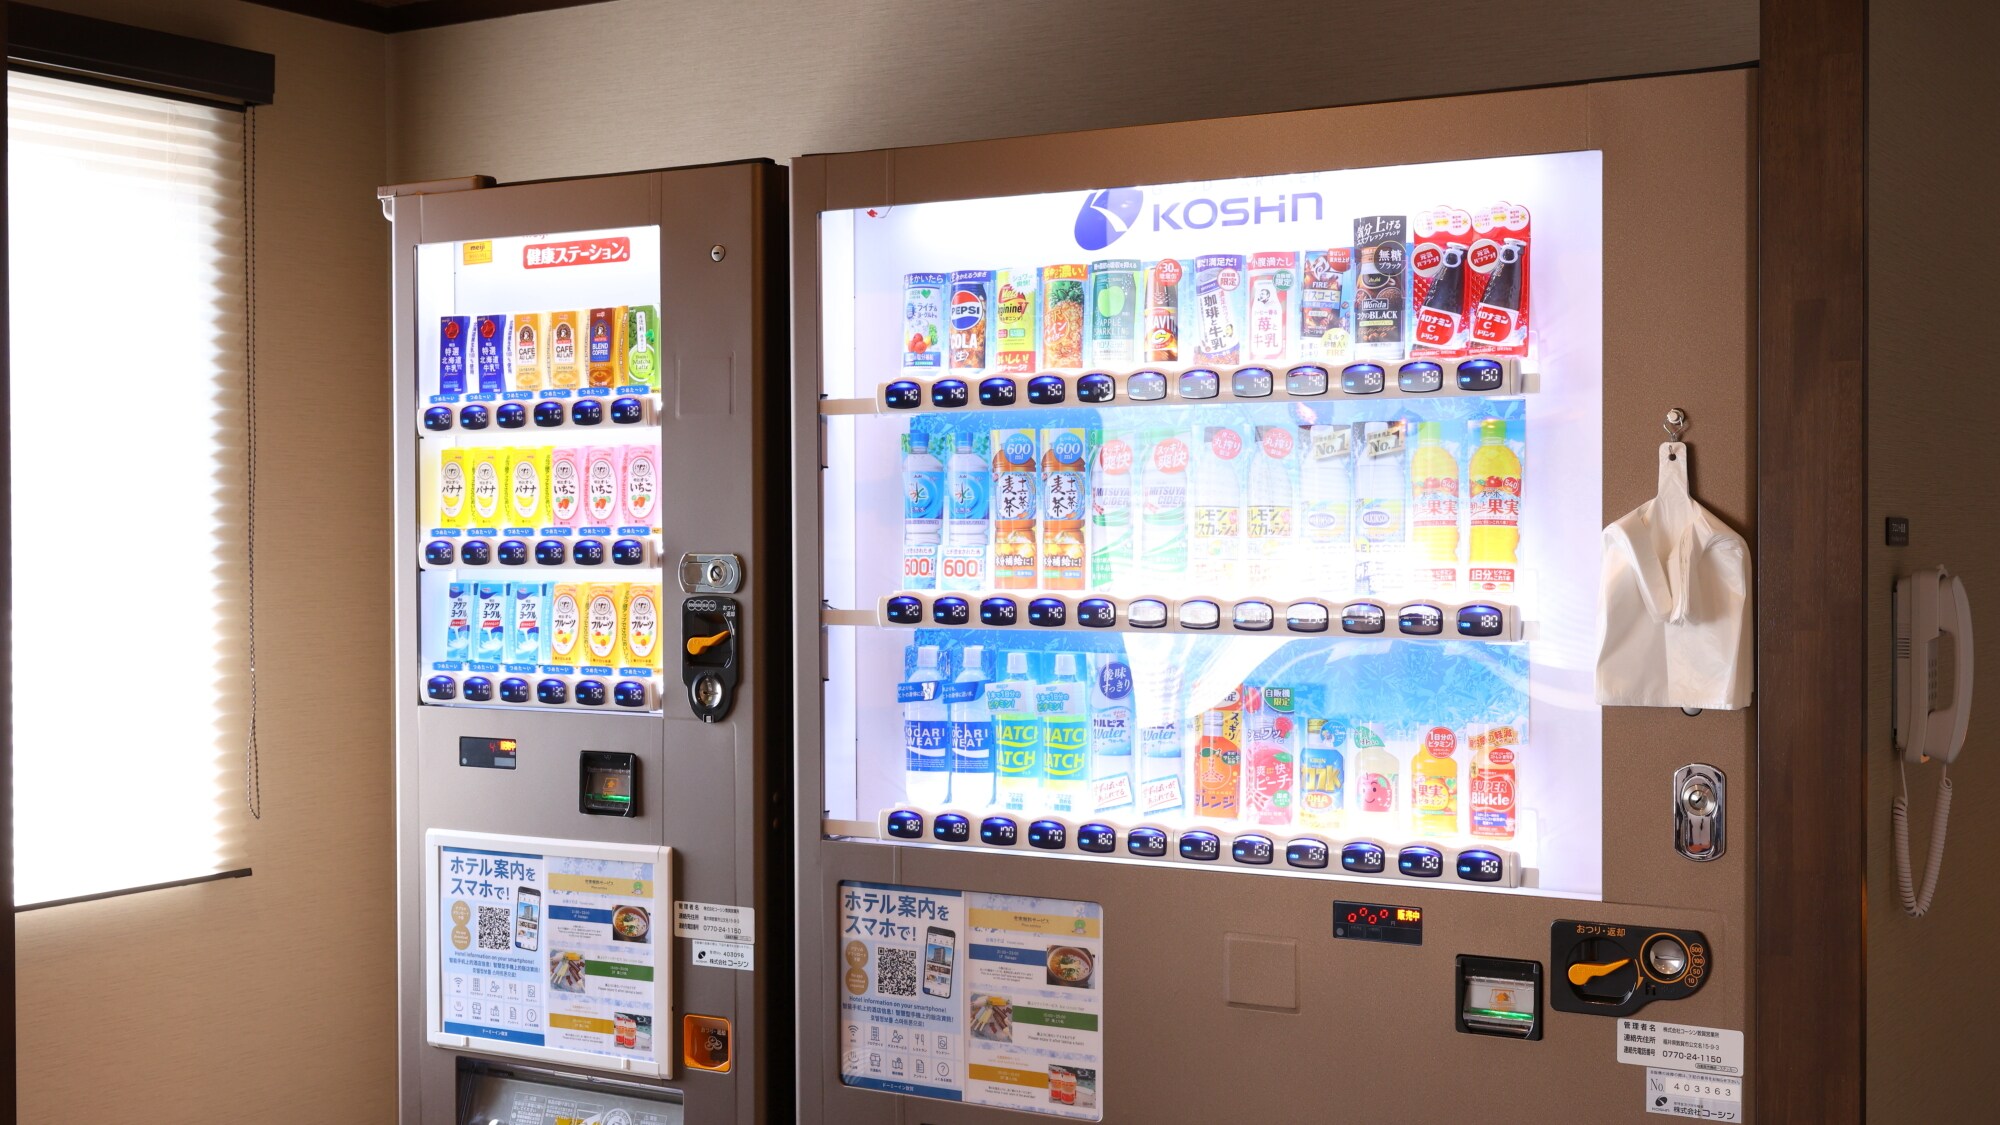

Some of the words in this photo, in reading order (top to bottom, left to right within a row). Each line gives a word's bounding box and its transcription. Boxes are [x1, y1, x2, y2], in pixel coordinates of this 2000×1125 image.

[1379, 250, 1402, 262] 無糖
[1380, 262, 1402, 270] ブラック
[952, 306, 980, 314] PEPSI
[1363, 300, 1387, 309] Wonda
[1370, 310, 1398, 320] BLACK
[1420, 314, 1452, 327] オロナミン
[1482, 322, 1492, 330] C
[1364, 373, 1381, 385] 160
[1422, 370, 1438, 384] 150
[1481, 368, 1498, 382] 150
[1254, 377, 1269, 388] 140
[904, 390, 918, 400] 140
[951, 388, 965, 399] 140
[998, 386, 1012, 397] 140
[1048, 384, 1062, 396] 150
[1006, 443, 1031, 455] 600
[1056, 443, 1080, 455] 600
[1213, 438, 1241, 450] 丸搾り
[1264, 437, 1292, 450] 丸搾り
[1368, 430, 1402, 458] No.1
[442, 484, 462, 494] バナナ
[476, 485, 496, 494] バナナ
[515, 485, 536, 494] バナナ
[554, 485, 576, 494] いちご
[591, 484, 612, 494] いちご
[630, 482, 652, 492] いちご
[1150, 486, 1186, 496] MITSUYA
[1504, 480, 1518, 490] 540
[1002, 475, 1020, 517] 麦茶
[1050, 475, 1068, 517] 麦茶
[1097, 487, 1130, 496] MITSUYA
[1103, 496, 1130, 506] CIDER
[1158, 496, 1185, 505] CIDER
[1428, 500, 1458, 516] 果実
[1488, 500, 1519, 516] 果実
[440, 548, 451, 558] 130
[476, 548, 487, 558] 130
[512, 548, 524, 558] 130
[550, 548, 562, 558] 130
[590, 548, 601, 558] 130
[628, 548, 640, 558] 130
[944, 559, 978, 577] 600
[484, 602, 500, 610] アクア
[906, 605, 919, 616] 120
[952, 606, 966, 617] 120
[1000, 606, 1014, 618] 140
[1048, 607, 1062, 618] 140
[554, 619, 576, 628] フルーツ
[592, 621, 614, 630] フルーツ
[632, 621, 654, 630] フルーツ
[1482, 615, 1498, 628] 180
[1104, 666, 1127, 681] 後味
[1103, 680, 1131, 694] すっきり
[1266, 688, 1291, 698] 自販機
[1274, 698, 1290, 707] 限定
[1094, 728, 1126, 740] Water
[1429, 732, 1453, 742] 1日分の
[1428, 740, 1454, 749] ビタミン!
[1256, 775, 1293, 791] ピーチ
[1472, 780, 1508, 793] SUPER
[1418, 784, 1442, 796] 果実
[1472, 794, 1510, 806] Bikkle
[906, 820, 920, 831] 180
[952, 822, 967, 835] 180
[1098, 833, 1113, 845] 160
[1148, 836, 1164, 849] 160
[1200, 841, 1217, 853] 150
[1254, 844, 1270, 857] 150
[1308, 848, 1325, 860] 150
[1364, 853, 1381, 865] 150
[1422, 856, 1439, 869] 150
[1482, 860, 1498, 874] 160
[451, 856, 536, 882] ホテル案内を
[451, 878, 510, 900] スマホで!
[845, 891, 950, 921] ホテル案内を
[1397, 909, 1420, 922] 販売中
[845, 915, 916, 941] スマホで!
[1576, 924, 1626, 937] おつり・返却
[864, 998, 892, 1006] information
[914, 1004, 946, 1013] smartphone!
[1624, 1022, 1656, 1032] 管理者名
[1624, 1034, 1656, 1044] 連絡先住所
[1624, 1046, 1656, 1056] 連絡先電話番号
[1662, 1050, 1722, 1064] 0770-24-1150
[1650, 1078, 1665, 1092] No.
